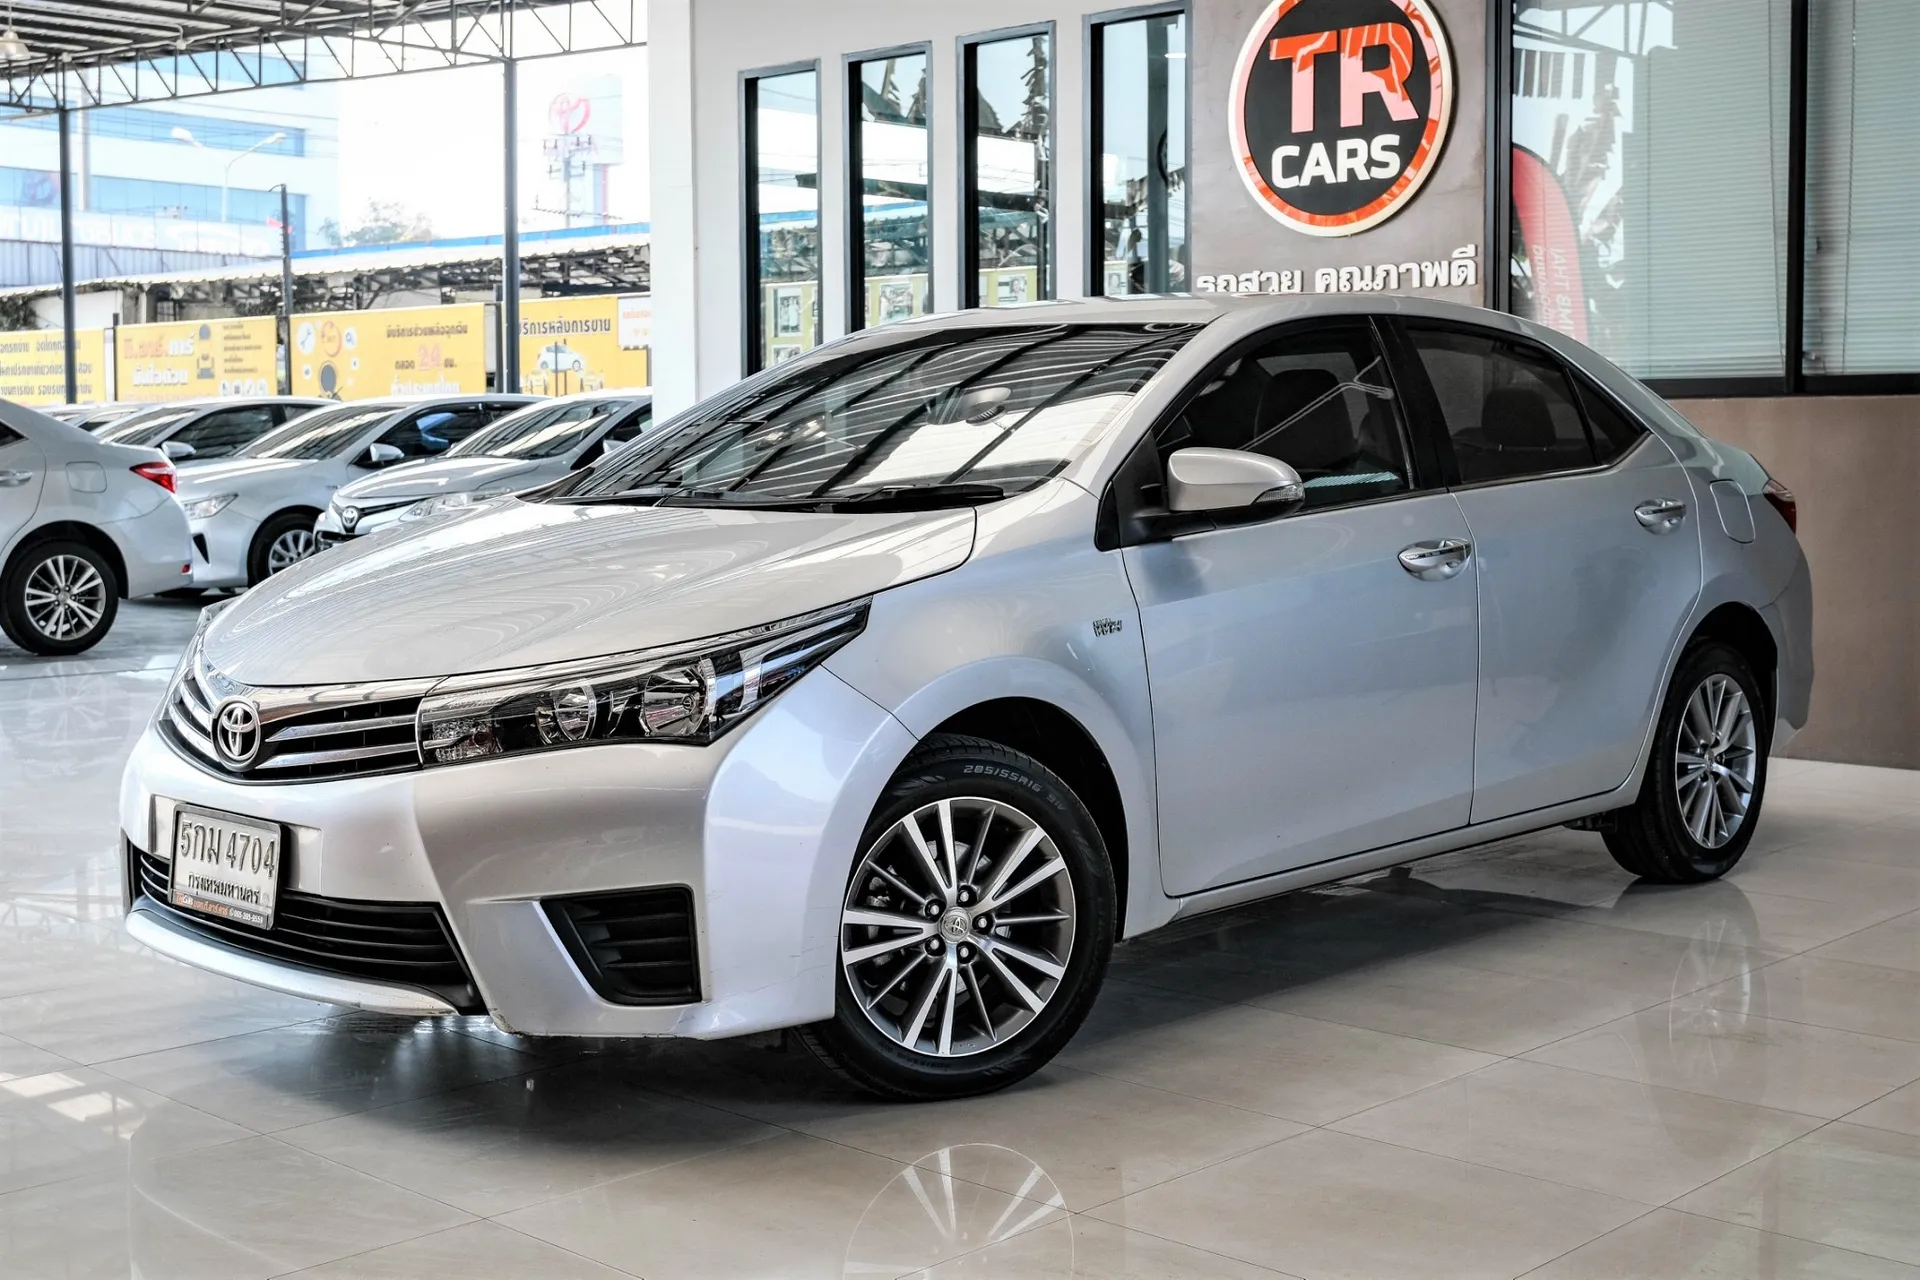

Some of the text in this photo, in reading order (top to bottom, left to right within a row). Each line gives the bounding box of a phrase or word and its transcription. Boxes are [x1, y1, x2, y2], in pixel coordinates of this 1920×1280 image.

[1269, 22, 1419, 133] TR
[1271, 134, 1401, 189] CARS
[1315, 244, 1477, 293] คณภาพดี
[418, 342, 442, 371] 24
[963, 764, 1042, 793] 205/55R16
[180, 819, 275, 879] 5กม 4704
